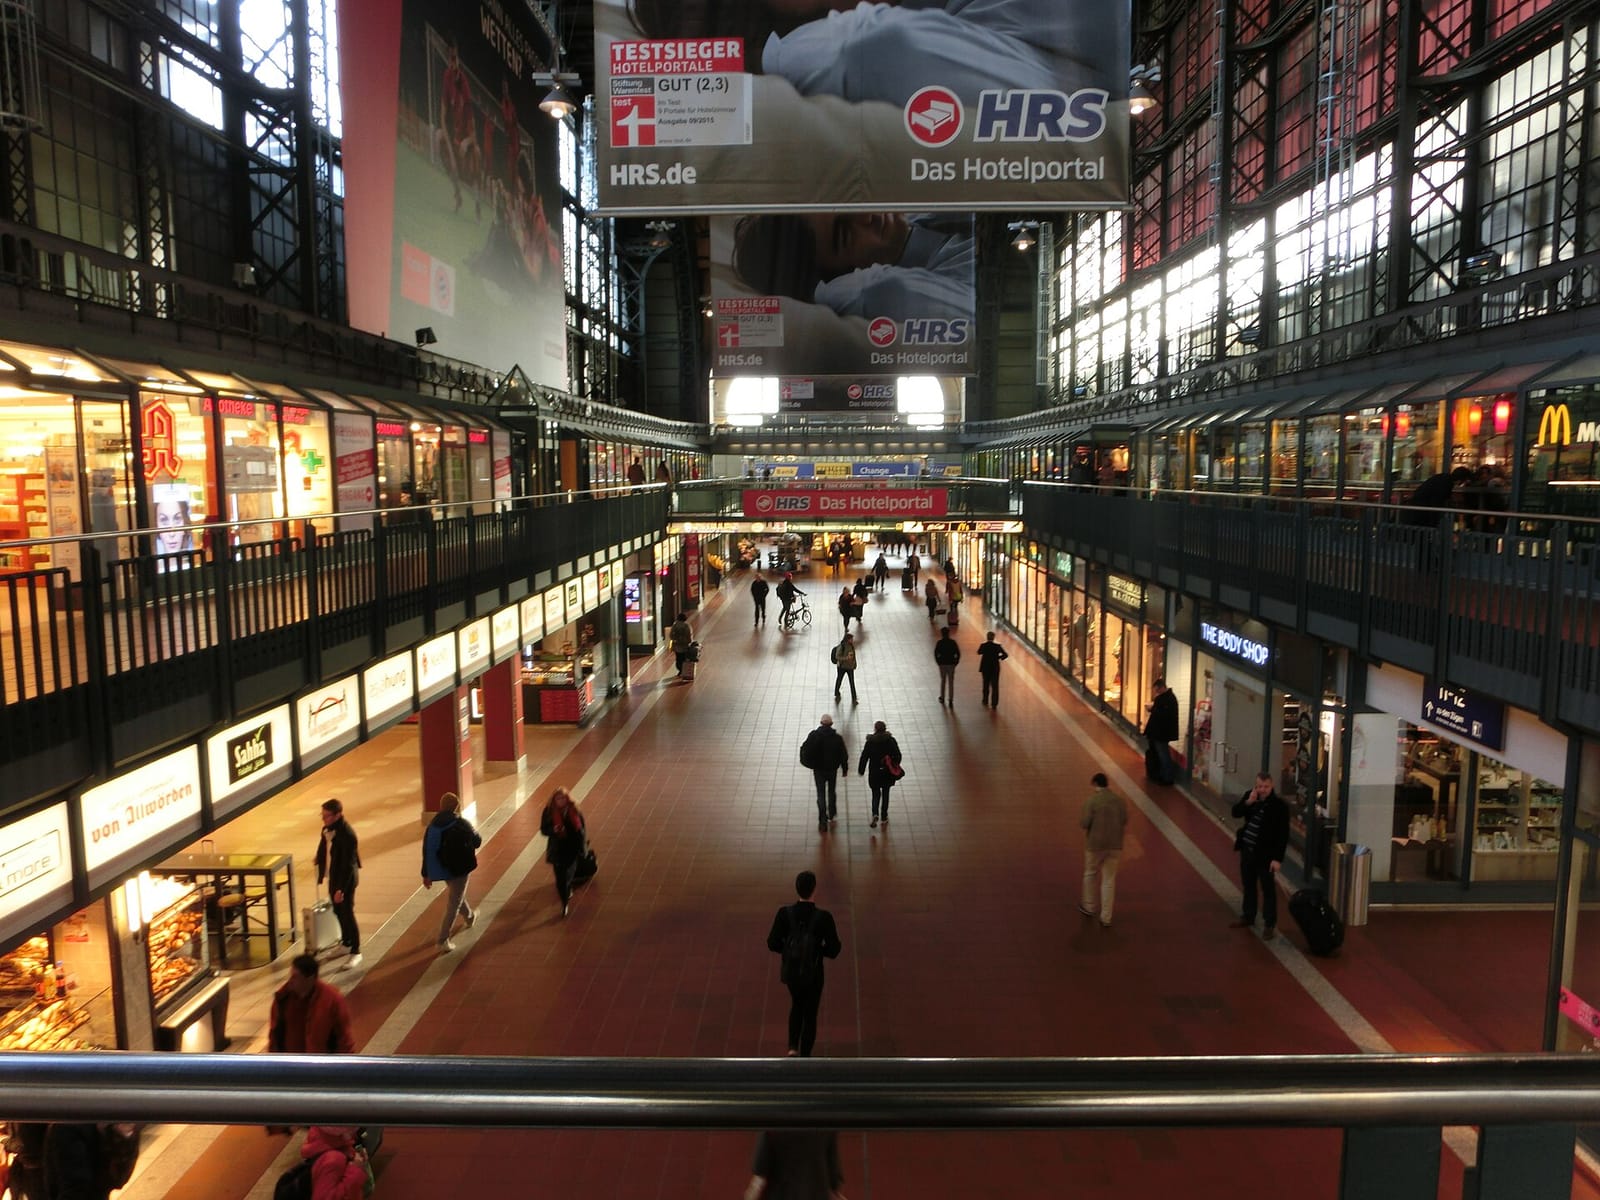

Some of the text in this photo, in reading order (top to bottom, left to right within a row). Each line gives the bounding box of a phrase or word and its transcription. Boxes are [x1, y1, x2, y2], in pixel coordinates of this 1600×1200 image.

[612, 41, 741, 61] TESTSIEGER
[612, 60, 713, 74] HOTELPORTALE
[658, 77, 729, 94] GUT (2,3)
[613, 98, 632, 106] test
[658, 118, 687, 126] Ausgabe
[973, 88, 1110, 143] HRS
[610, 163, 697, 186] HRS.de
[911, 156, 1104, 184] Das Hotelportal
[720, 300, 778, 308] TESTSIEGER
[903, 318, 970, 345] HRS
[719, 354, 762, 367] HRS.de
[871, 351, 968, 367] Das Hotelportal
[863, 385, 895, 399] HRS
[203, 398, 254, 416] Aotheke
[860, 467, 889, 476] Change
[774, 496, 933, 512] HRS Das Hotelportal
[1202, 623, 1269, 665] THE BODY SHOP
[92, 819, 120, 844] von
[7, 855, 51, 887] more
